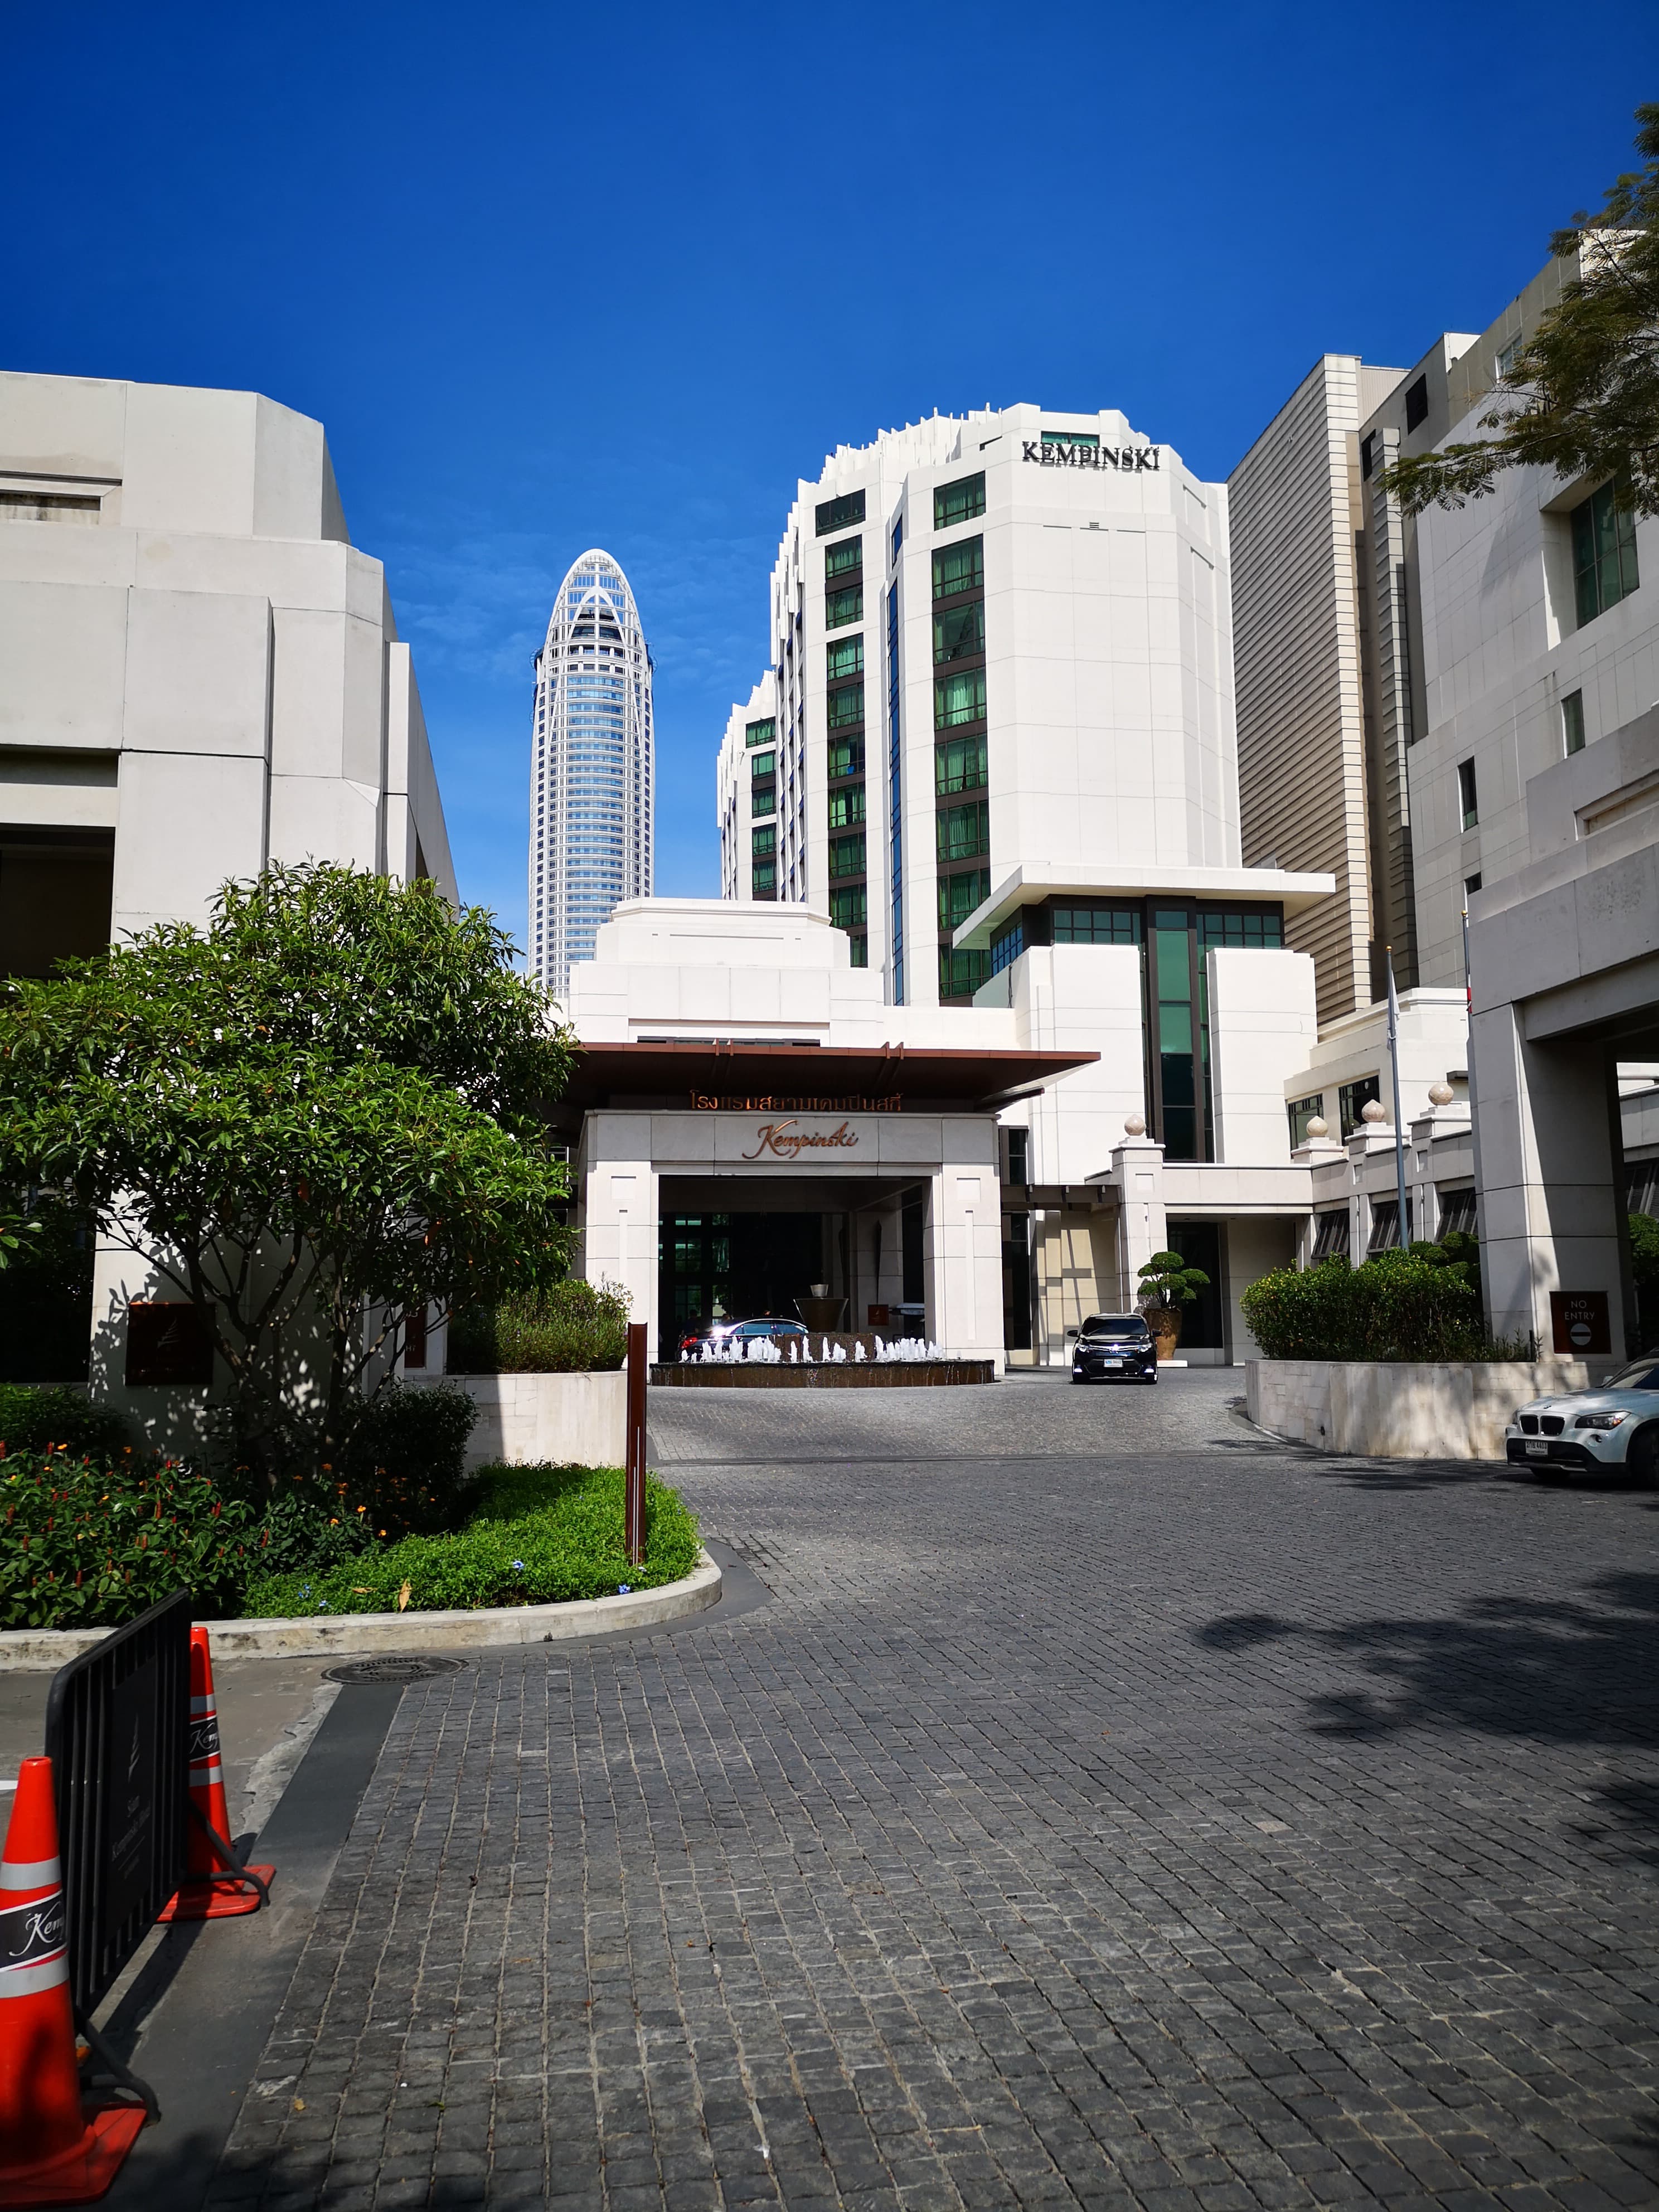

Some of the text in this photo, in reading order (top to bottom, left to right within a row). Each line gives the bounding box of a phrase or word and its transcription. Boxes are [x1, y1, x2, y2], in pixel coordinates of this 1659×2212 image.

[1022, 441, 1161, 469] KEMPINSKI
[741, 1119, 859, 1159] Kempinski
[1570, 1299, 1587, 1309] NO
[1564, 1311, 1595, 1320] ENTRY
